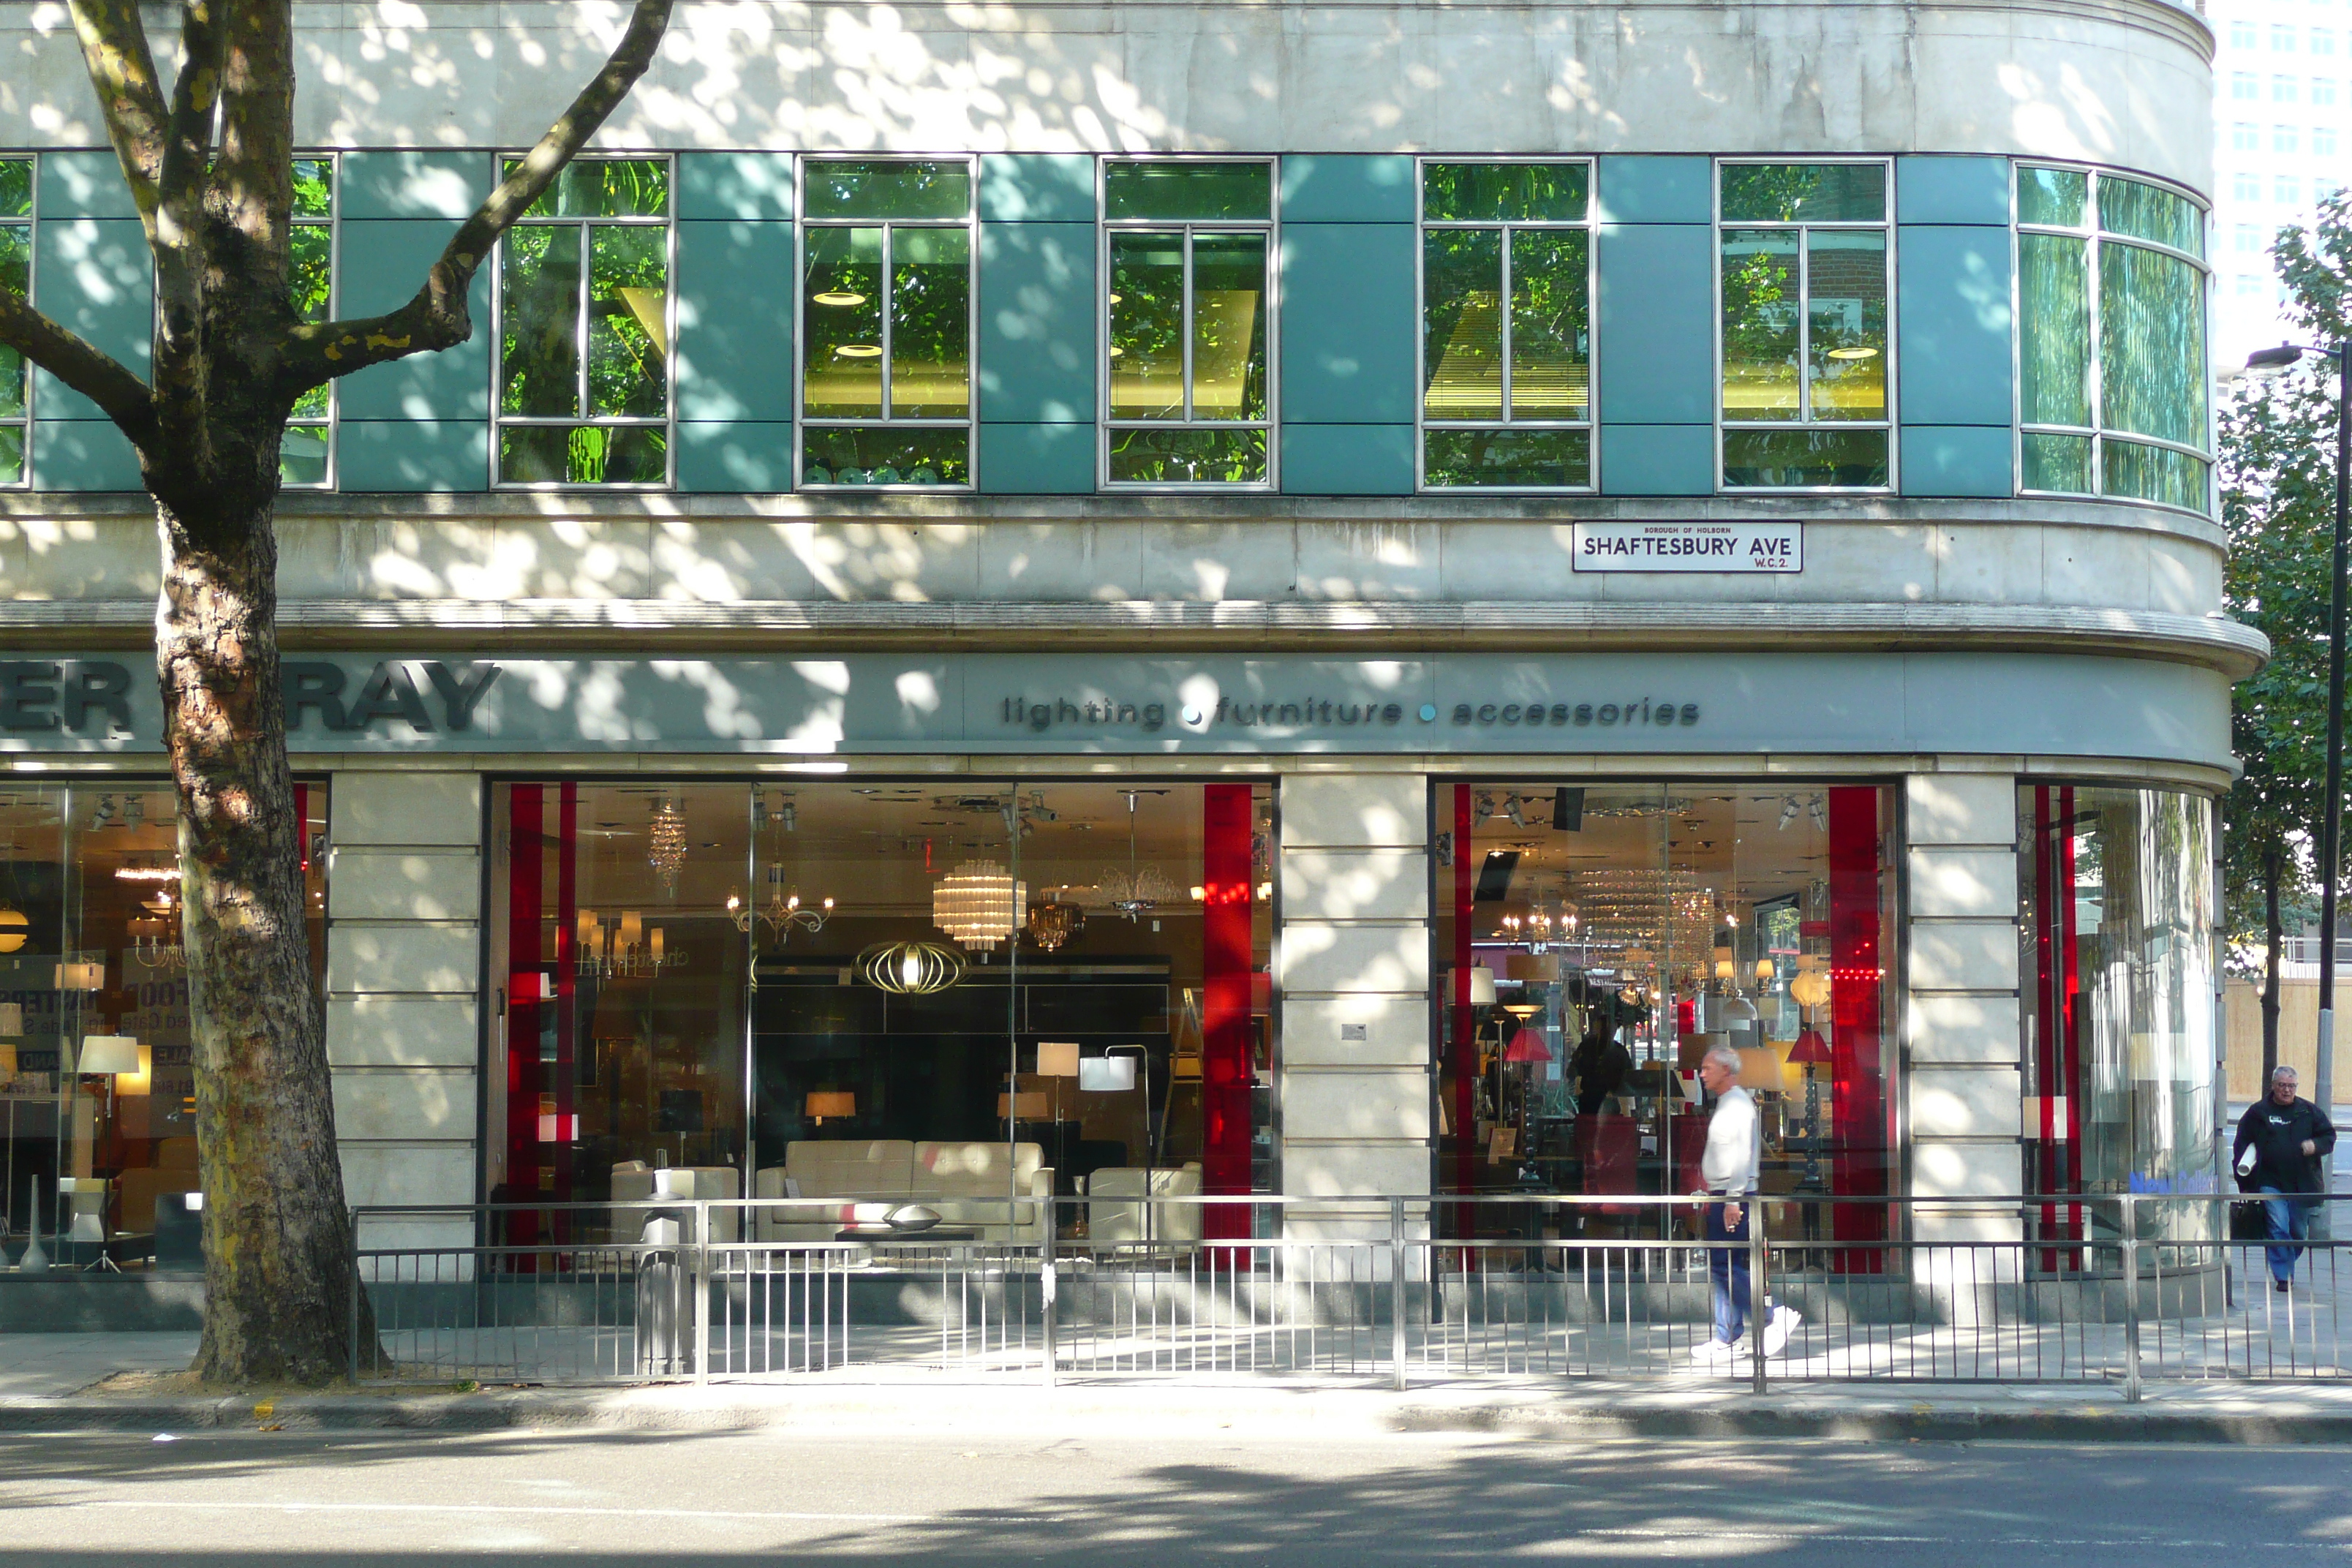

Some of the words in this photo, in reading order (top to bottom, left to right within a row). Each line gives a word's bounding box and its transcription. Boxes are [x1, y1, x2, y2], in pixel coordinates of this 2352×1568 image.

[1644, 527, 1679, 535] BOROUGH
[1683, 527, 1693, 535] OF
[1696, 527, 1732, 535] HOLBORN
[1583, 537, 1739, 556] SHAFTESBURY
[1749, 538, 1793, 556] AVE
[281, 661, 497, 730] RAY
[1004, 696, 1164, 731] lighting
[1216, 696, 1403, 724] furniture
[1452, 696, 1700, 727] accessories
[2129, 1170, 2173, 1194] New
